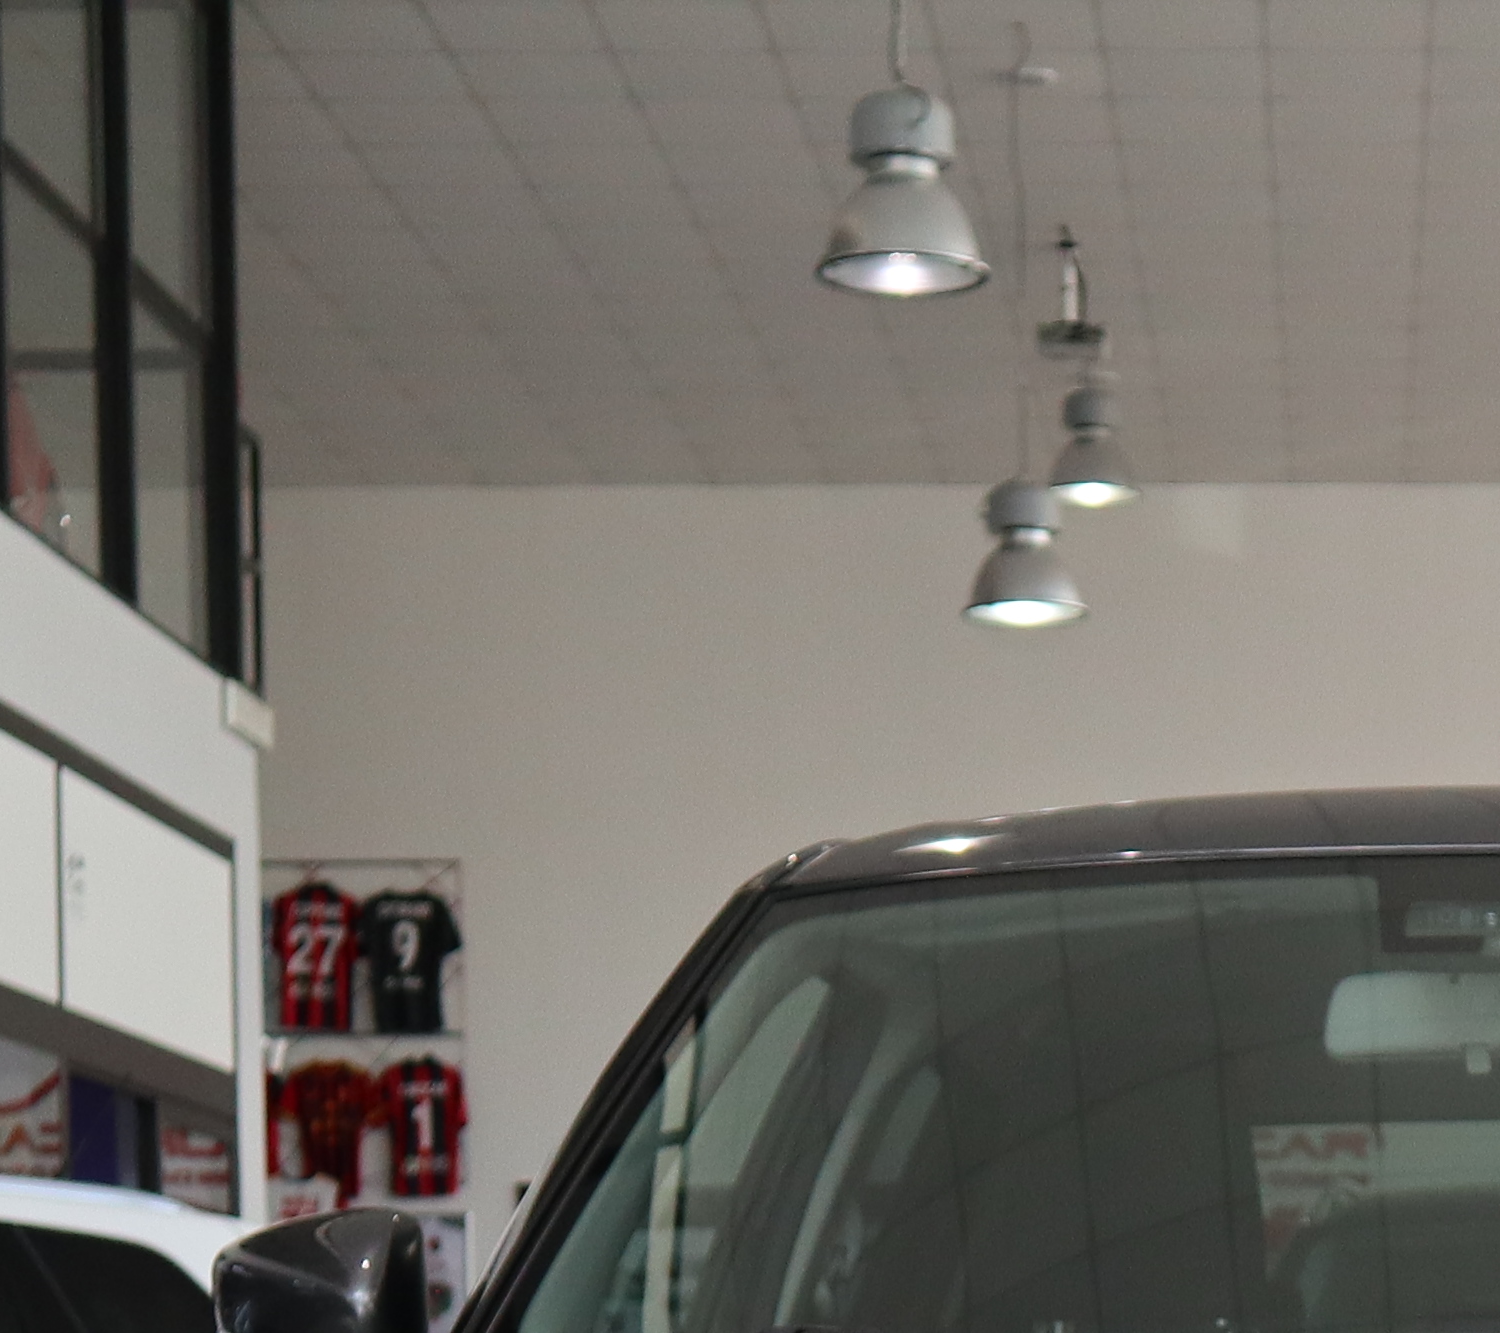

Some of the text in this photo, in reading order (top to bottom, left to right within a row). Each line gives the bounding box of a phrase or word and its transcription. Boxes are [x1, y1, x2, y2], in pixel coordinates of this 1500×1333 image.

[286, 923, 347, 976] 27
[392, 919, 420, 971] 9
[411, 1099, 433, 1147] 1
